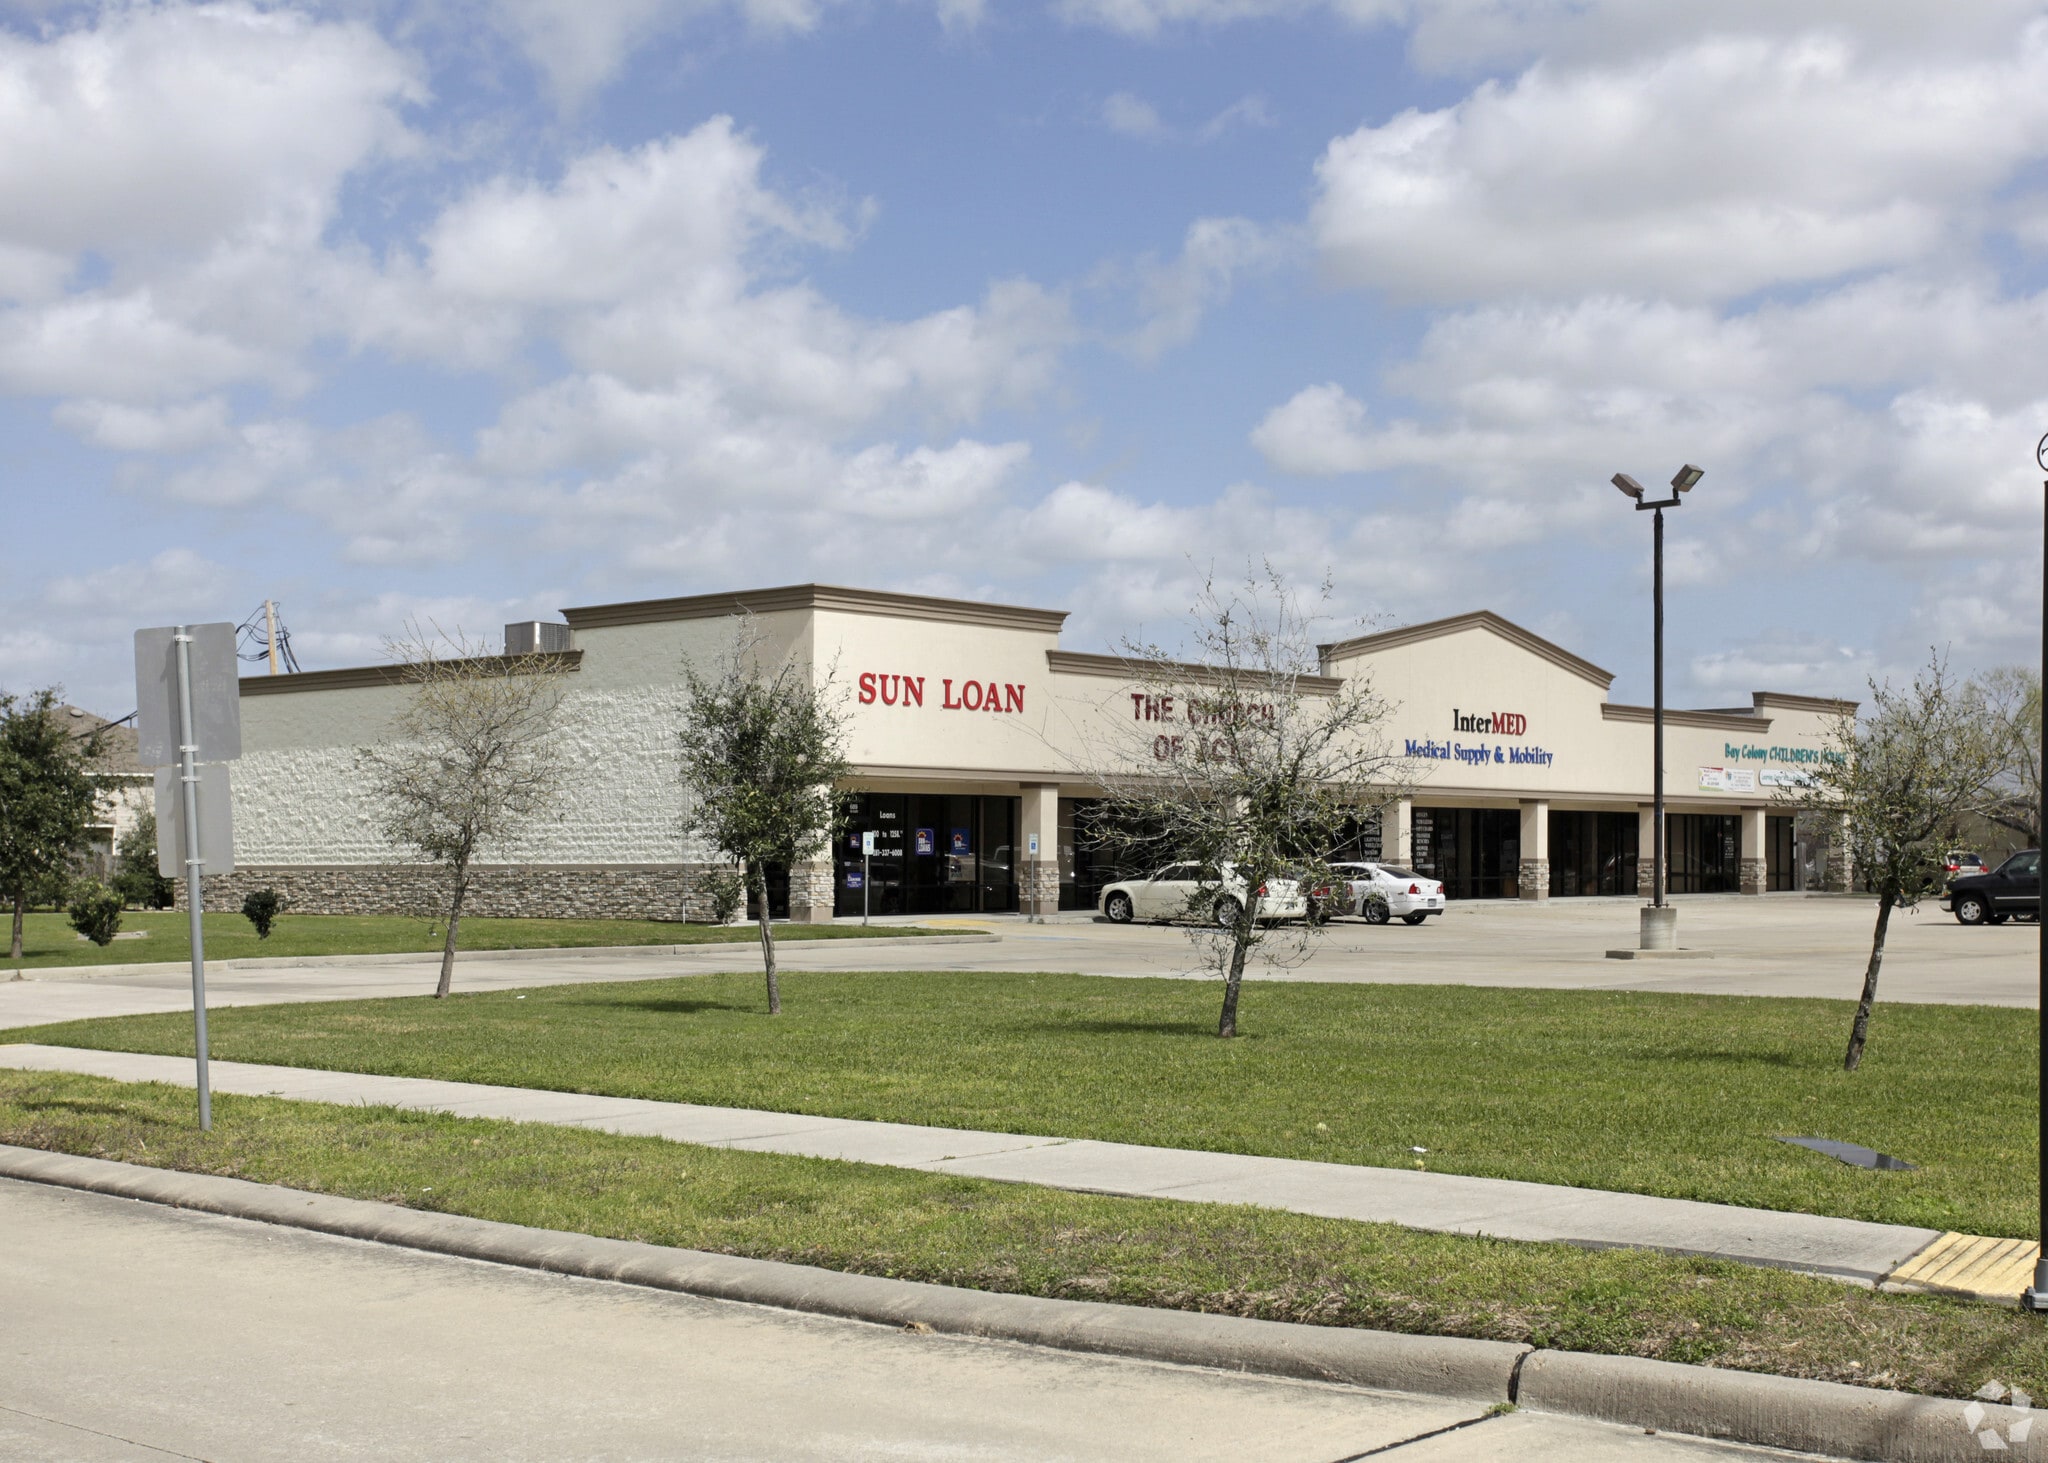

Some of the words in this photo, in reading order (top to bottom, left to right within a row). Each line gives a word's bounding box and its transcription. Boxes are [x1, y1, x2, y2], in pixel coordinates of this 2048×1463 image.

[858, 672, 925, 707] SUN
[942, 678, 1026, 714] LOAN
[1131, 693, 1174, 723] THE
[1453, 708, 1527, 736] InterMED
[1154, 734, 1183, 761] OF
[1404, 739, 1451, 760] Medical
[1454, 742, 1491, 766] Supply
[1494, 745, 1505, 763] &
[1509, 746, 1553, 768] Mobility
[1742, 743, 1769, 764] Colony
[1769, 746, 1819, 764] CHILDREN'S
[879, 810, 896, 819] Loans
